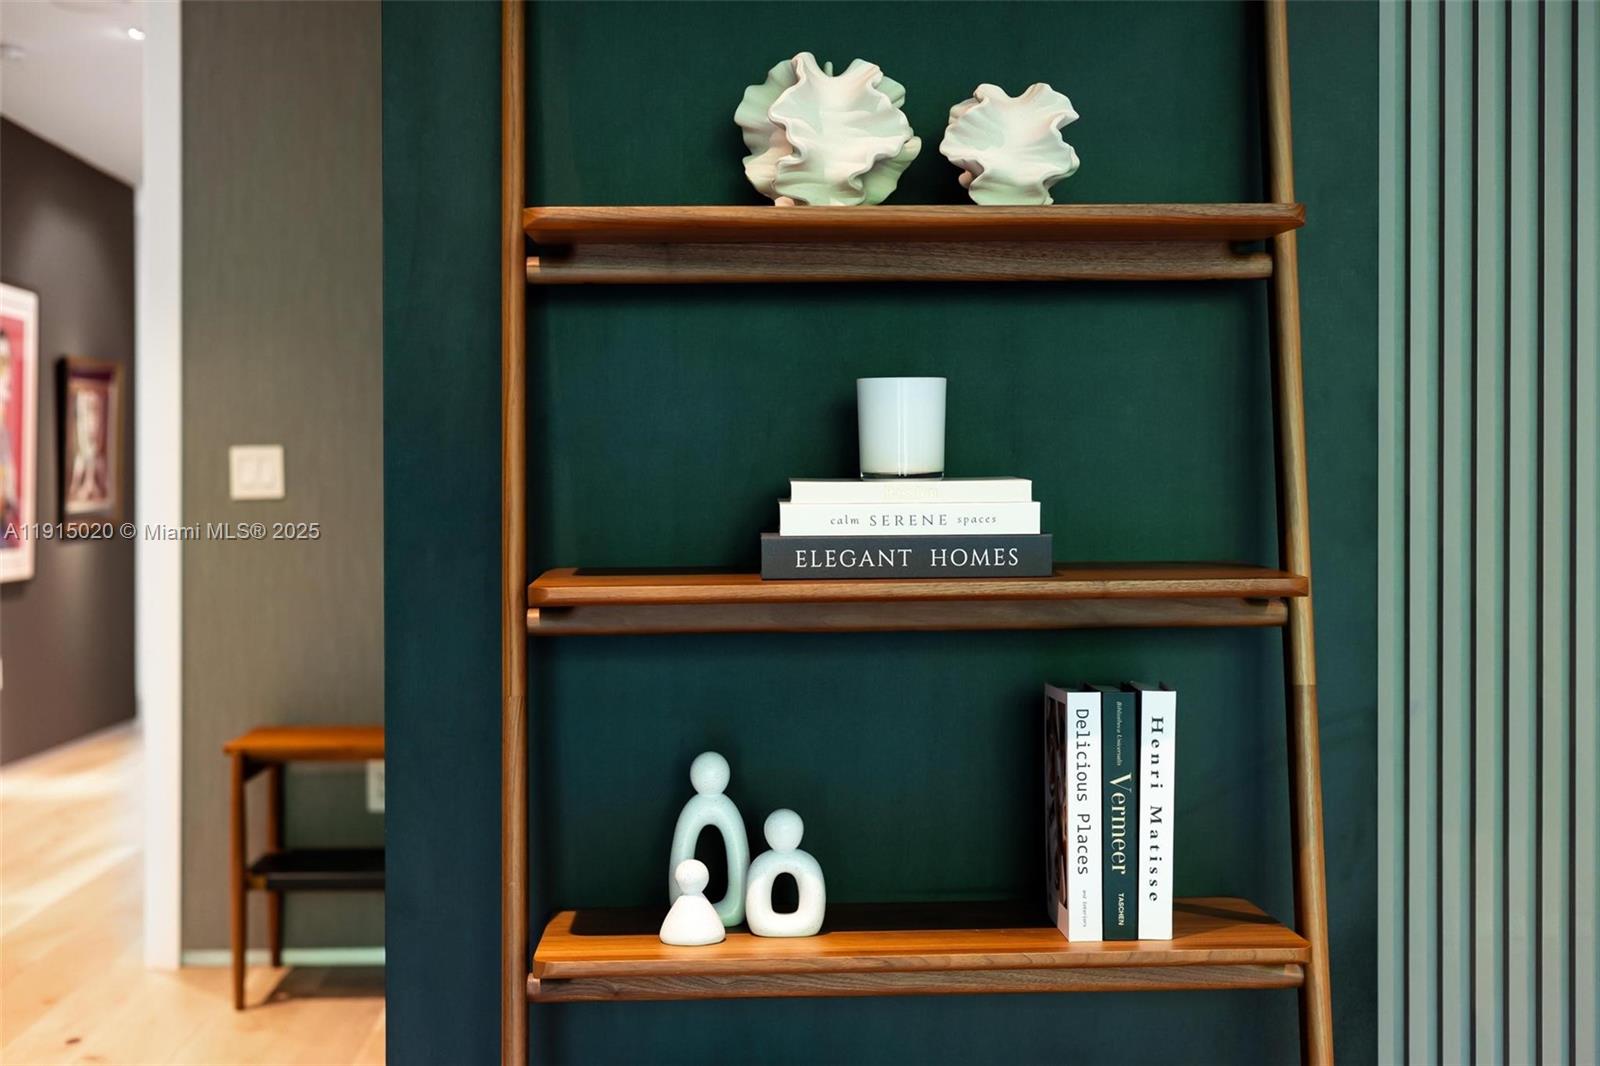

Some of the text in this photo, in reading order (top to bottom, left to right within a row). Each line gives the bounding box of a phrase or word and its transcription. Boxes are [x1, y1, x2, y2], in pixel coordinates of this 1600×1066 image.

[795, 548, 1019, 568] ELEGANT HOMES
[830, 514, 997, 527] calm SERENE spaces
[1076, 709, 1092, 875] Delicious Places
[1109, 772, 1132, 875] Vermeer
[1149, 716, 1164, 901] Henri Matisse
